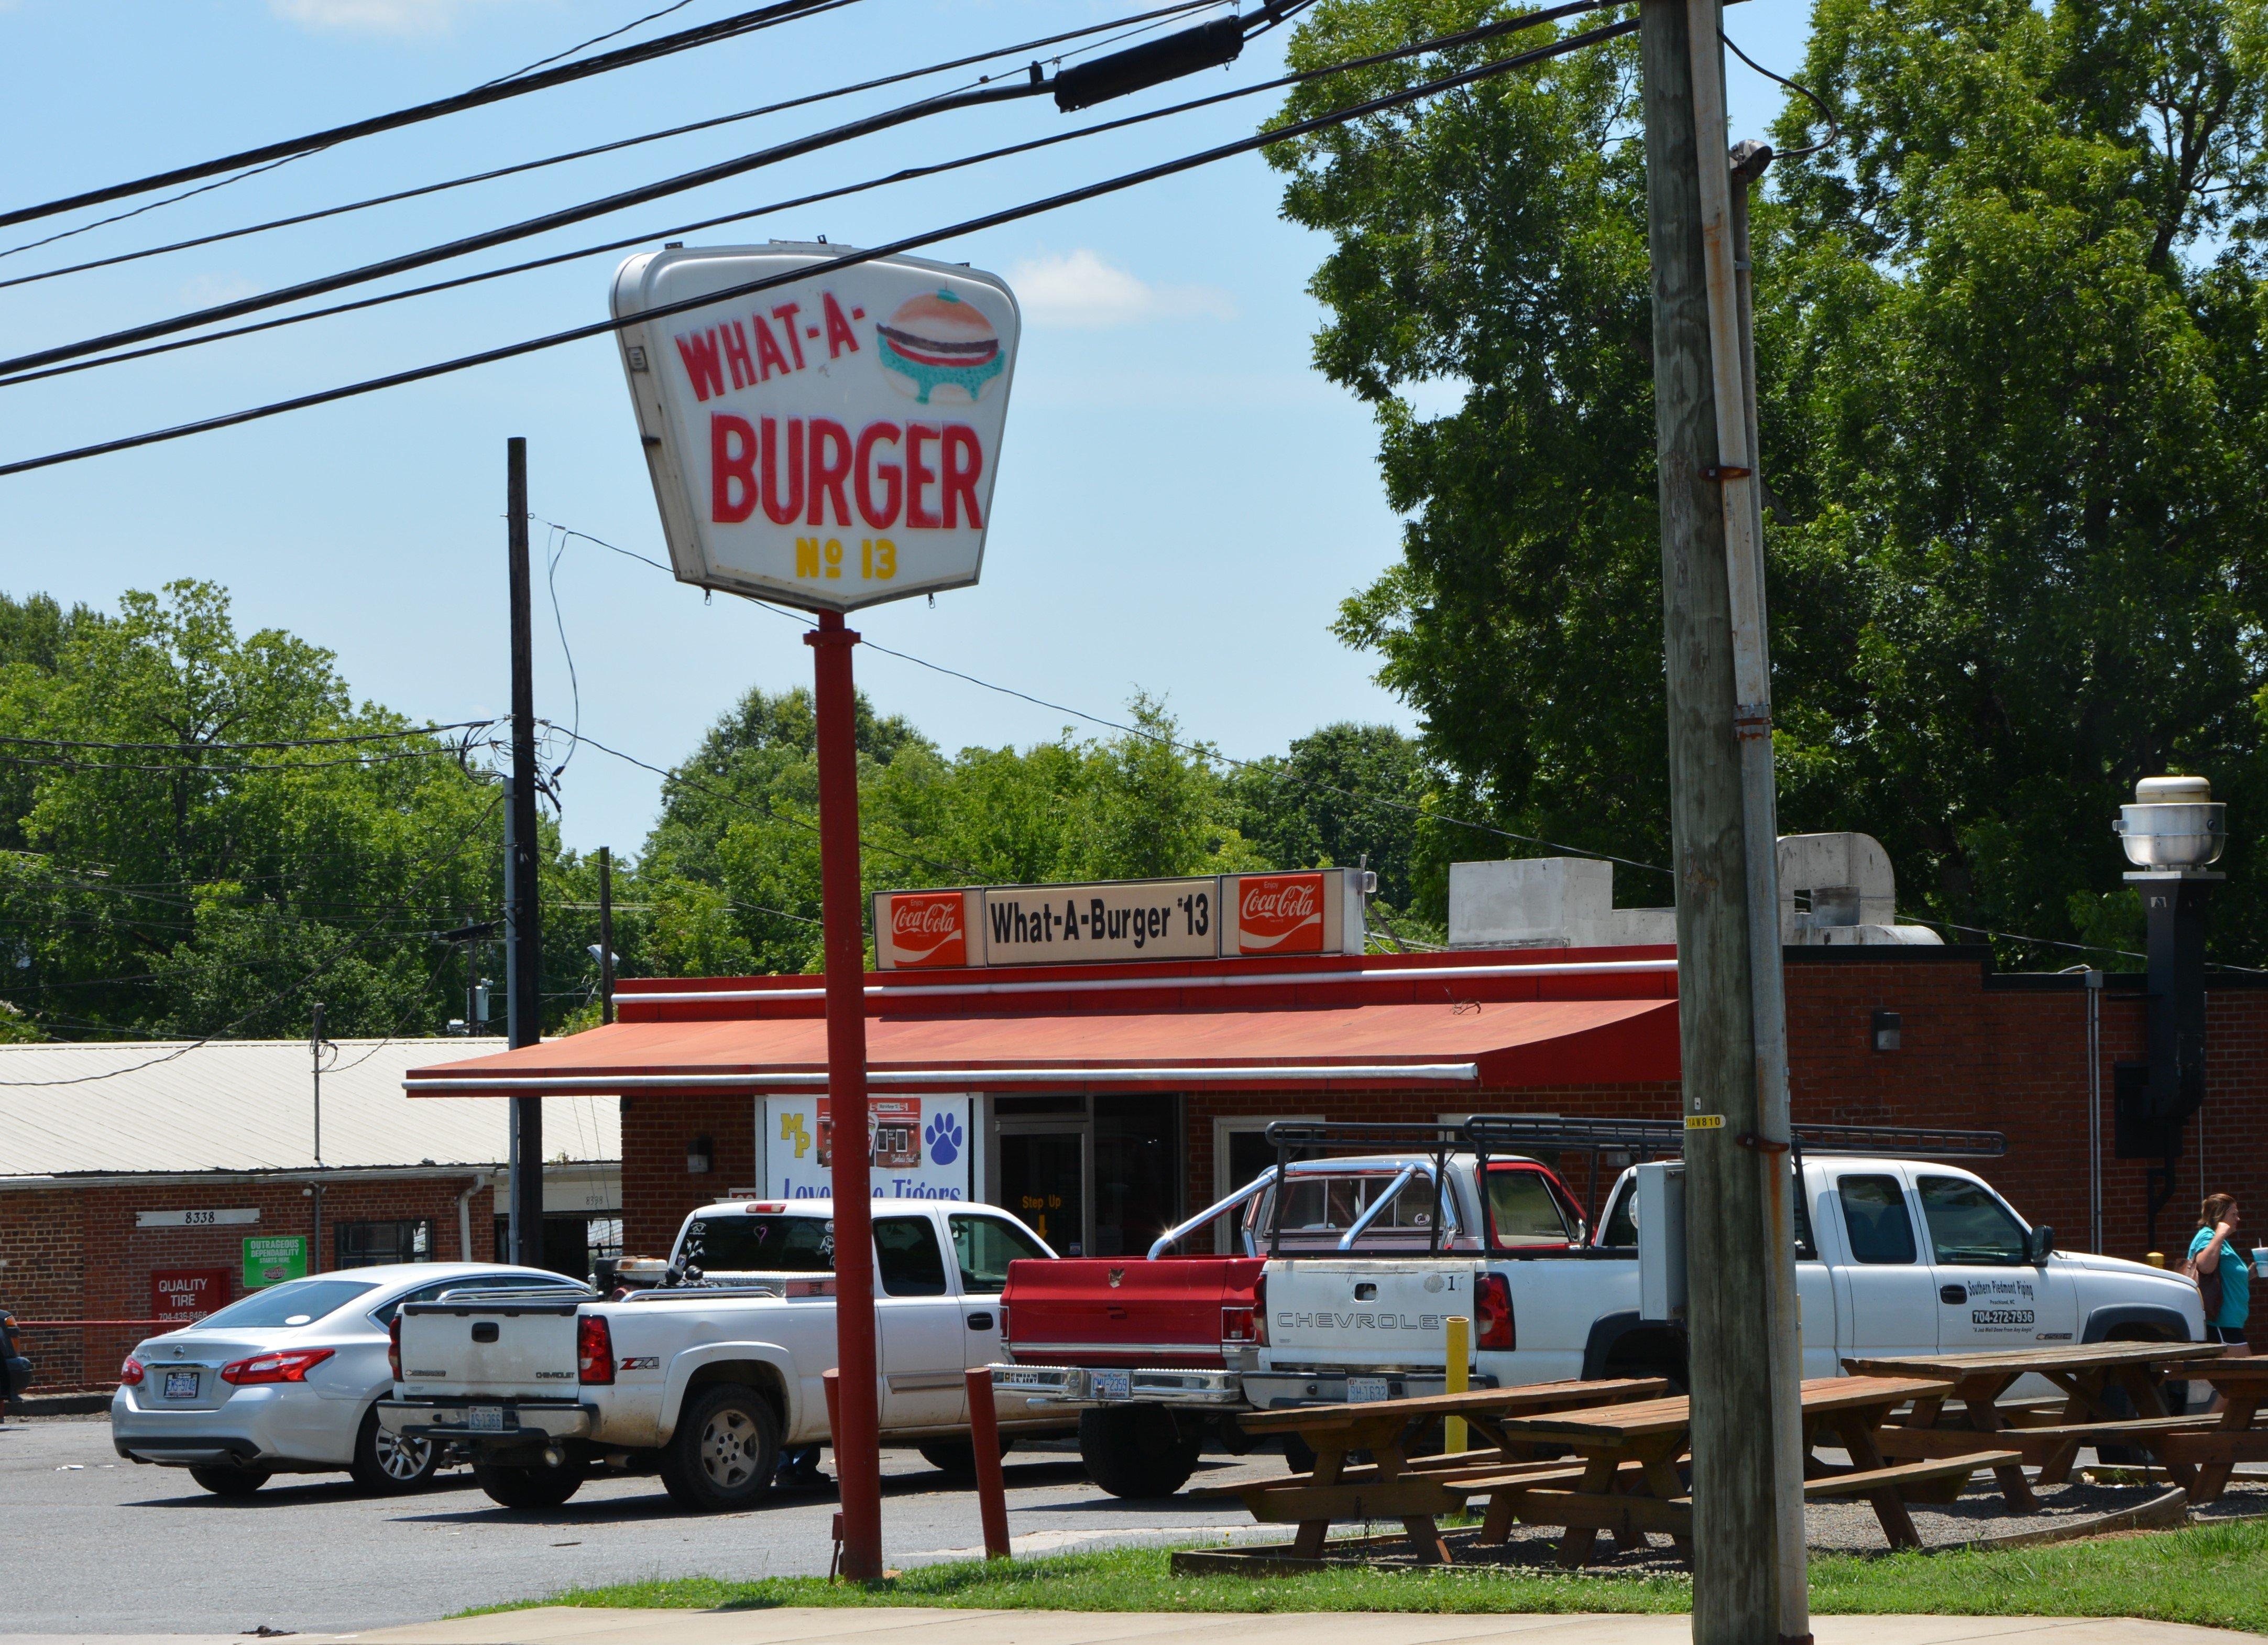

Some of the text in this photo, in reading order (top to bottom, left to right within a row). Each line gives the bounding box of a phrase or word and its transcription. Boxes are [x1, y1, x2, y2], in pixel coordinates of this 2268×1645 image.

[675, 288, 865, 402] WHAT-A-
[710, 410, 983, 530] BURGER
[862, 538, 897, 580] 13
[1264, 881, 1279, 889] Enjoy
[911, 899, 924, 907] Enjoy
[1242, 884, 1317, 920] Coca-Cola
[892, 903, 957, 935] Coca-Cola
[990, 892, 1209, 949] What-A-Burger #13
[1023, 1194, 1062, 1211] Step Up
[185, 1211, 215, 1224] 8338
[250, 1239, 299, 1249] OUTRAGEOUS
[250, 1248, 299, 1258] DEPENDABILITY
[158, 1278, 208, 1293] QUALITY
[1968, 1280, 2034, 1302] Southern Piedmont Piping
[170, 1293, 196, 1308] TIRE
[619, 1356, 660, 1370] Z71
